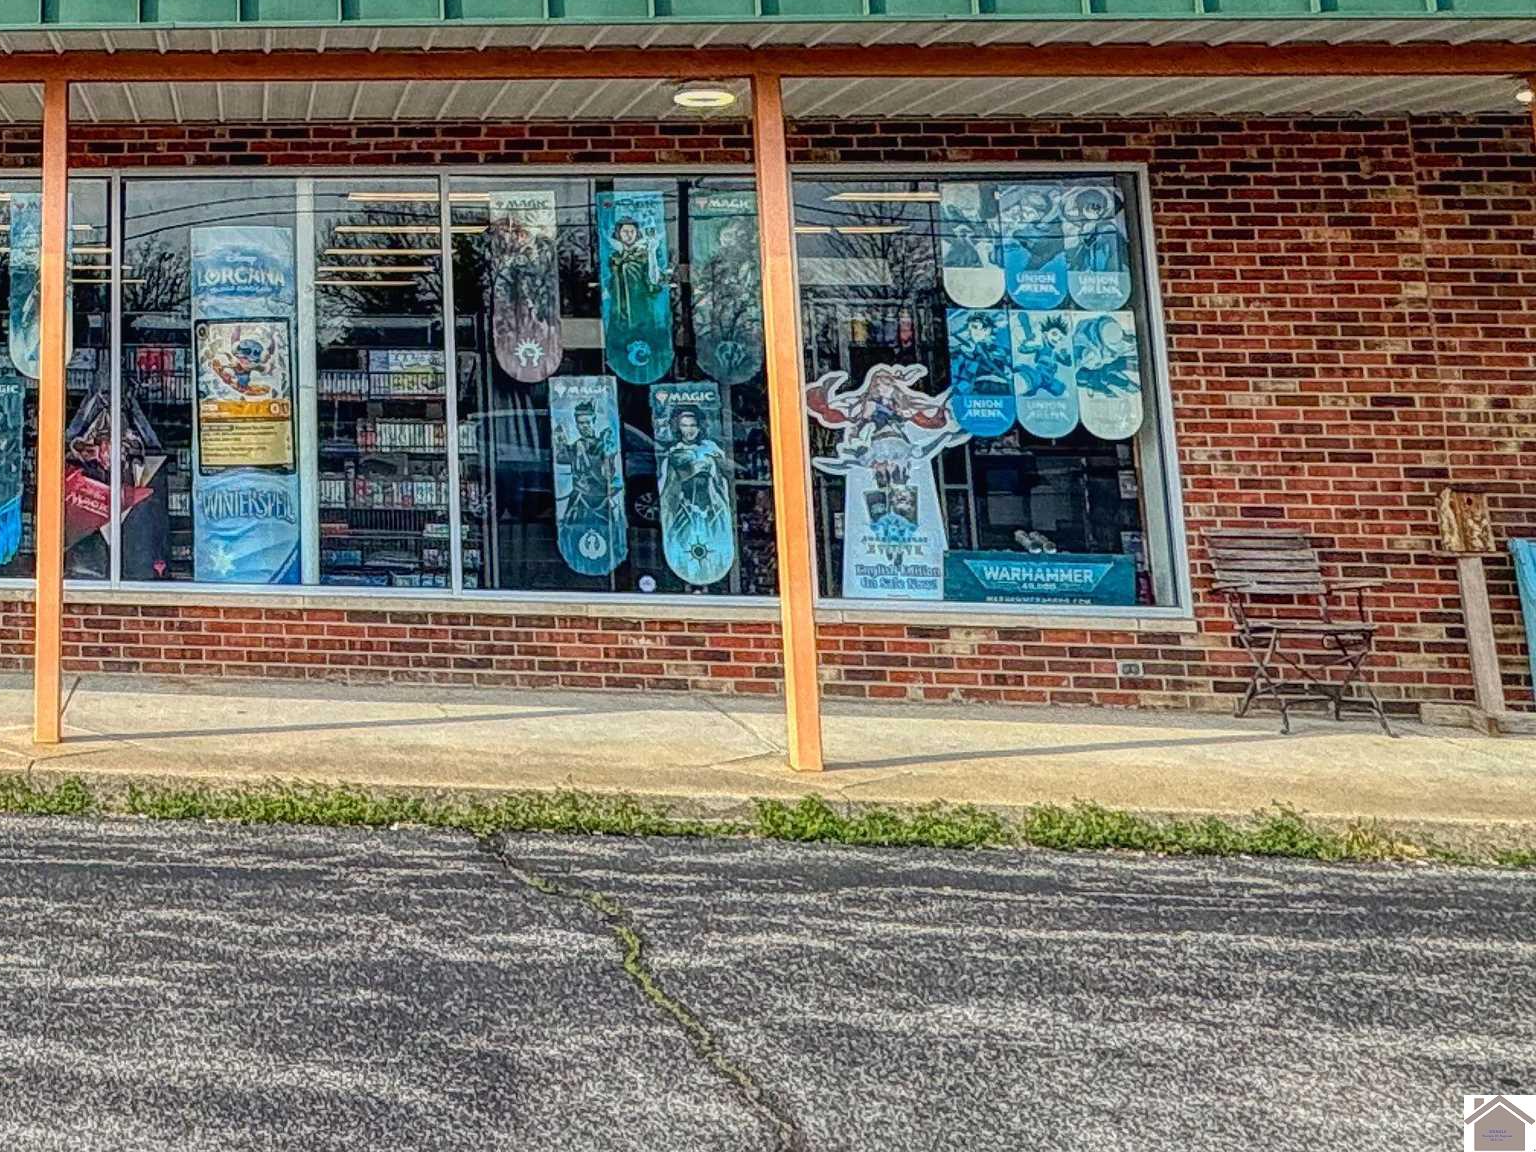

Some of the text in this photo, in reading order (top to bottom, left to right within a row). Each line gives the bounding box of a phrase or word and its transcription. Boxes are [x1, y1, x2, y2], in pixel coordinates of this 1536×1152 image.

[1016, 272, 1056, 283] UNION
[1078, 274, 1119, 285] UNION
[668, 391, 715, 402] MAGIC
[965, 399, 1003, 409] UNION
[983, 565, 1095, 584] WARHAMMER
